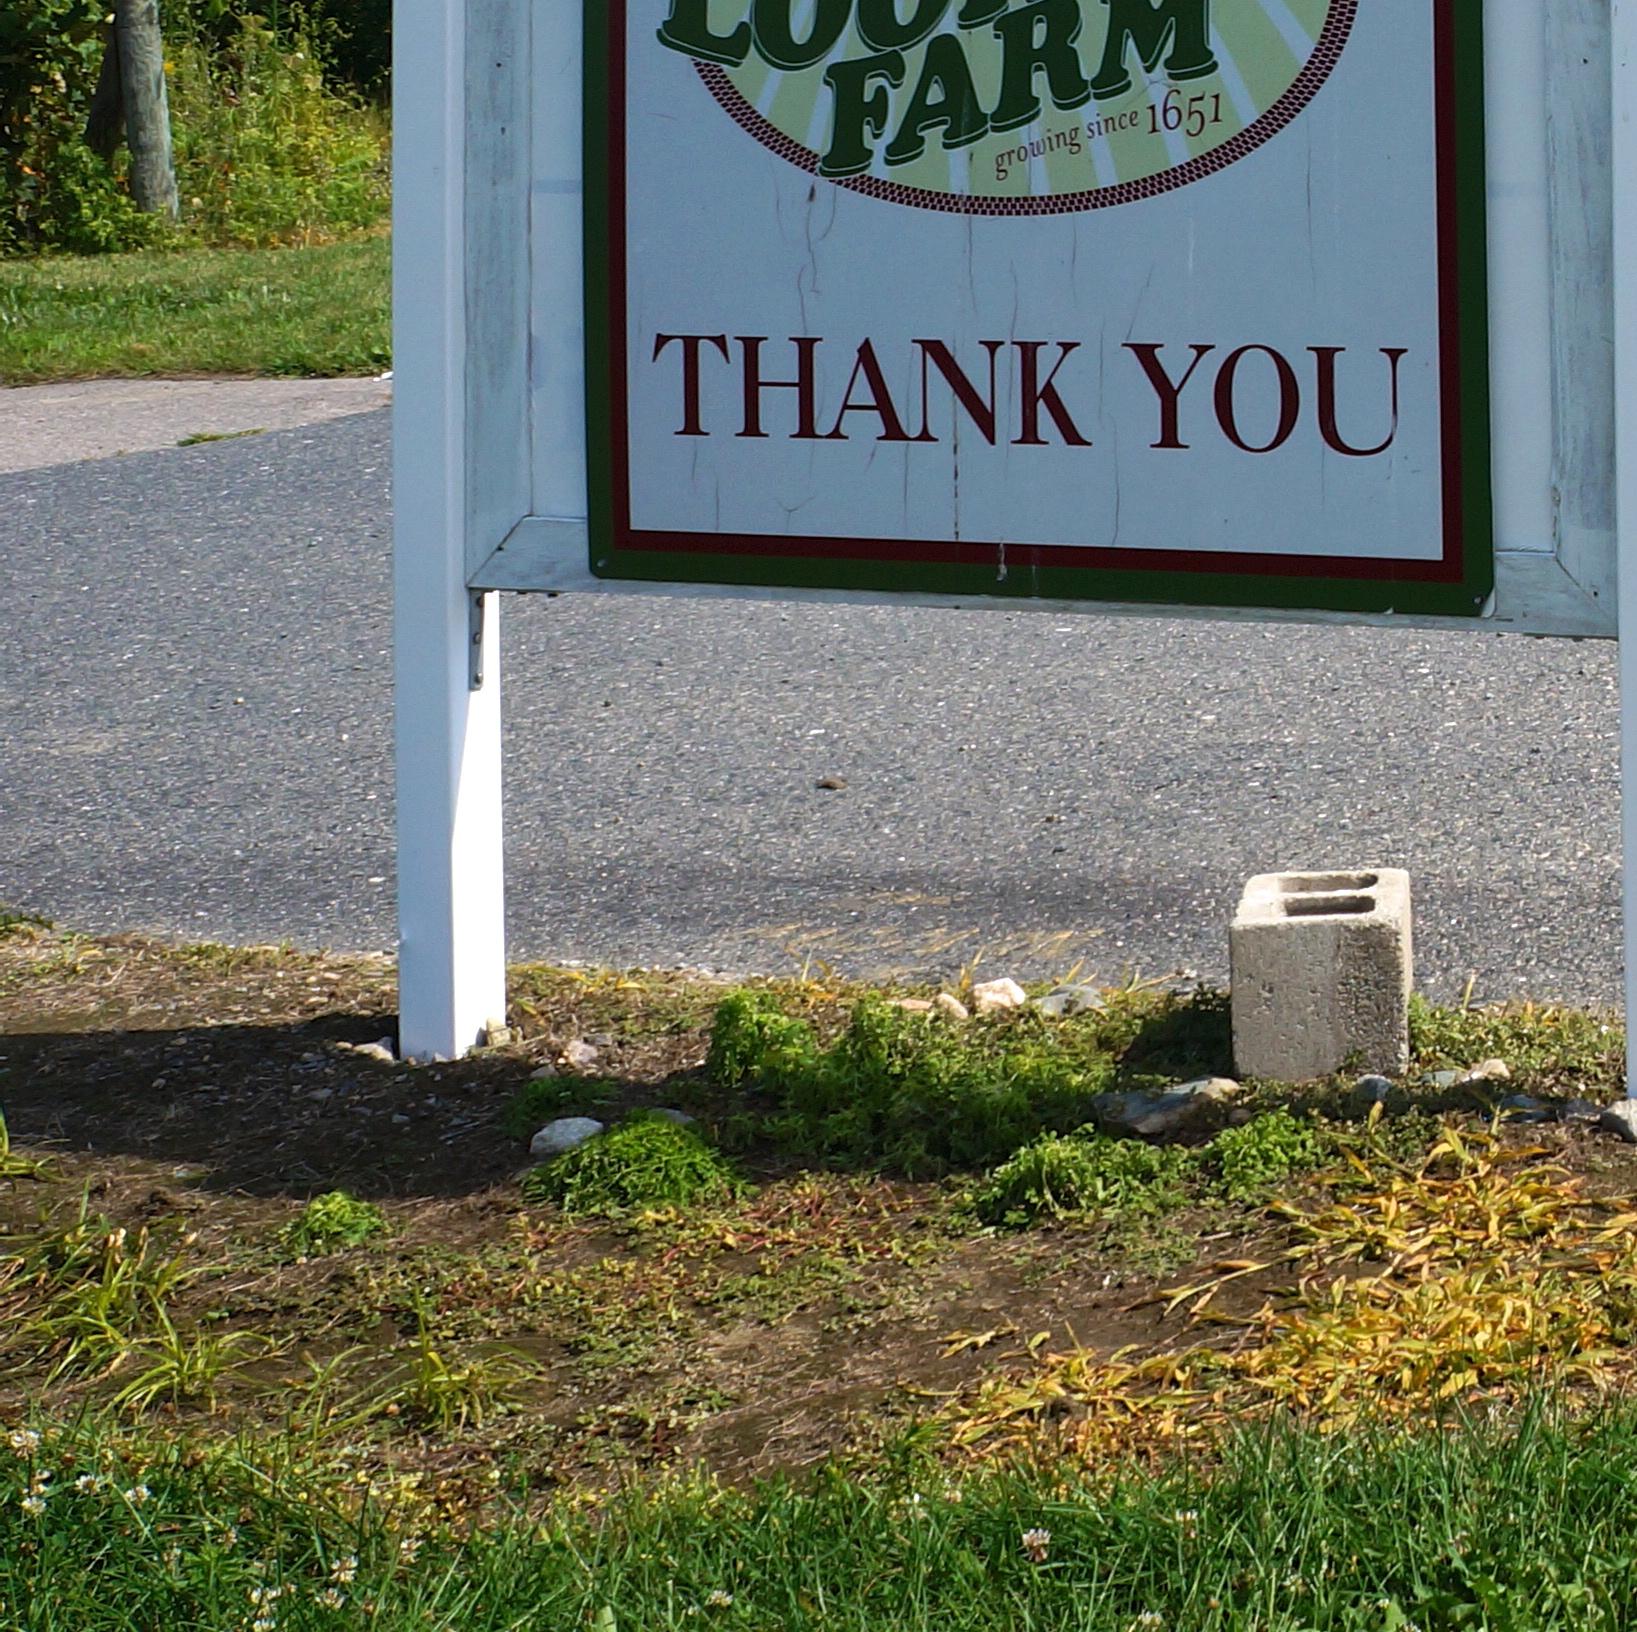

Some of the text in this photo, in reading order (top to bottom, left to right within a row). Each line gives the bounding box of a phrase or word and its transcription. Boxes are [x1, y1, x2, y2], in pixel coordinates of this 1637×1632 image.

[995, 89, 1223, 181] growing since 1651
[652, 332, 1408, 458] THANK YOU
